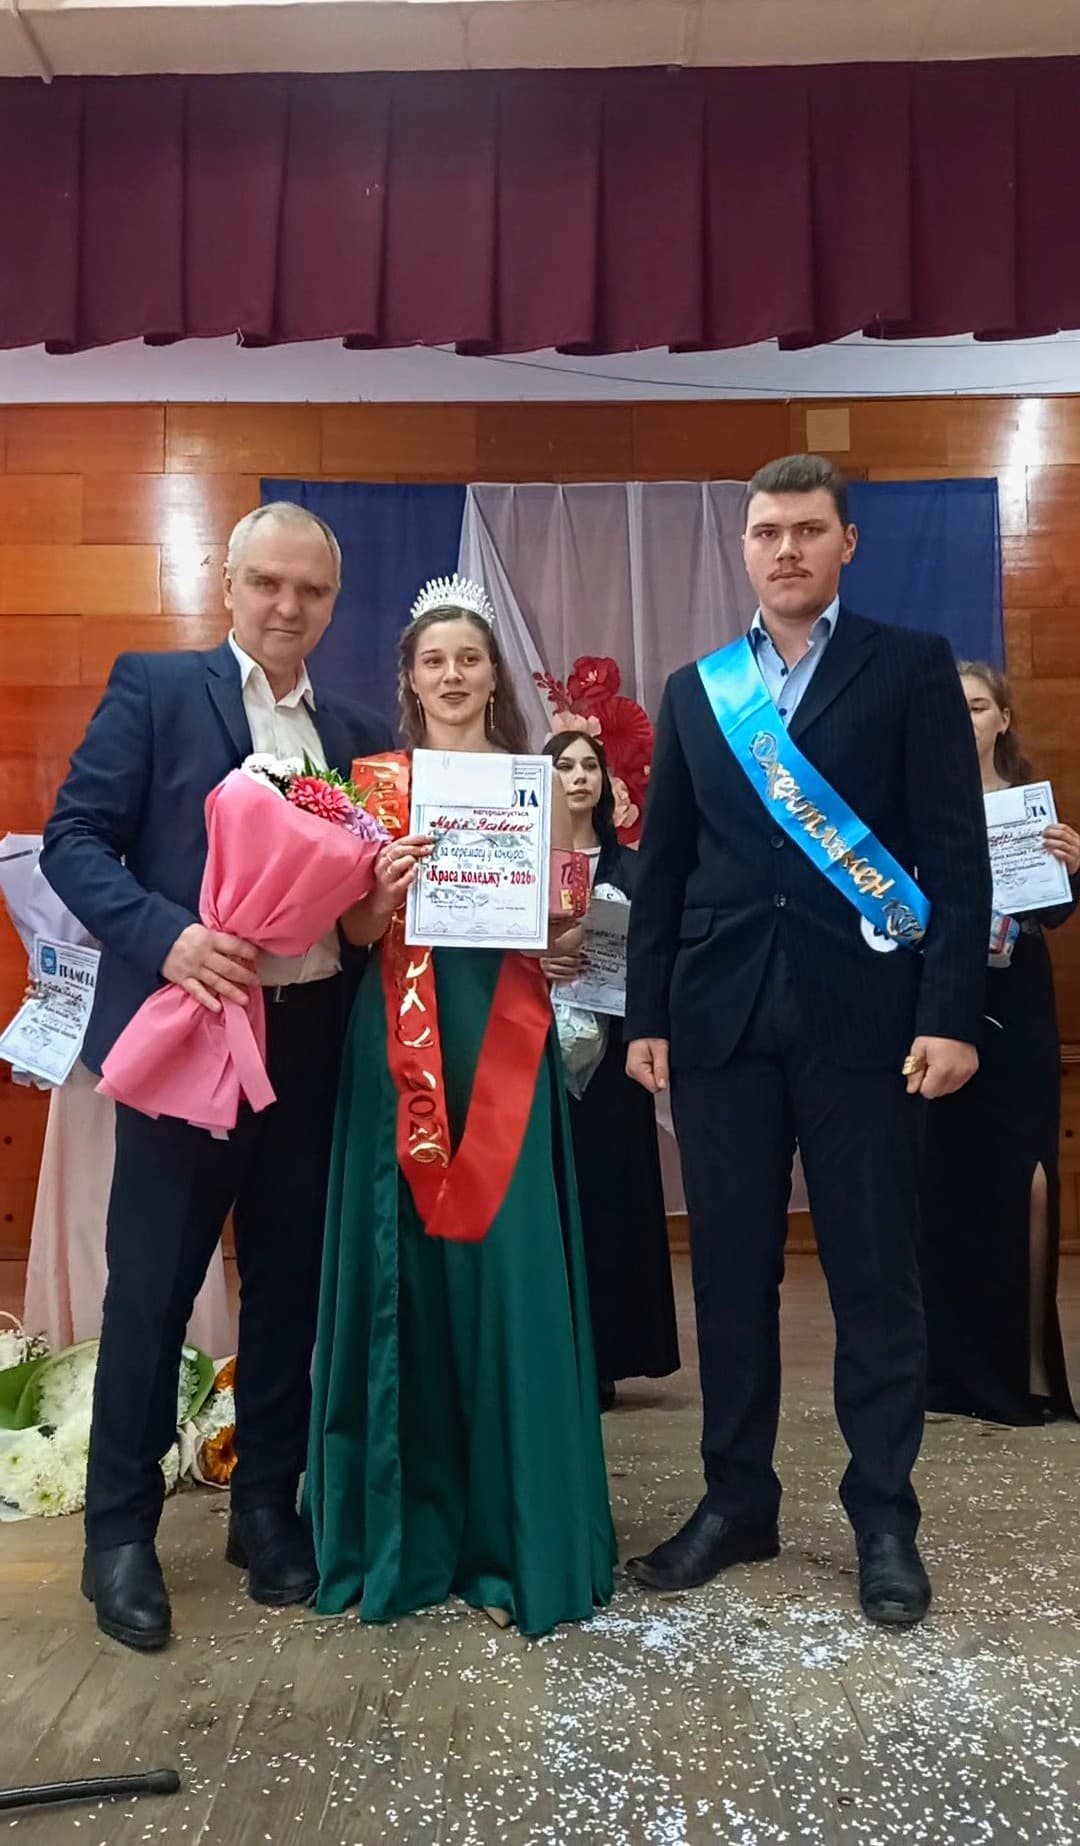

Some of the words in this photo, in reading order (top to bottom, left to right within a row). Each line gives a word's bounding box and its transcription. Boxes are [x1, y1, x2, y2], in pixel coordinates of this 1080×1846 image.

[440, 847, 449, 856] за
[451, 847, 486, 862] перемогу
[461, 870, 502, 888] коледжу
[403, 1069, 449, 1168] 2026
